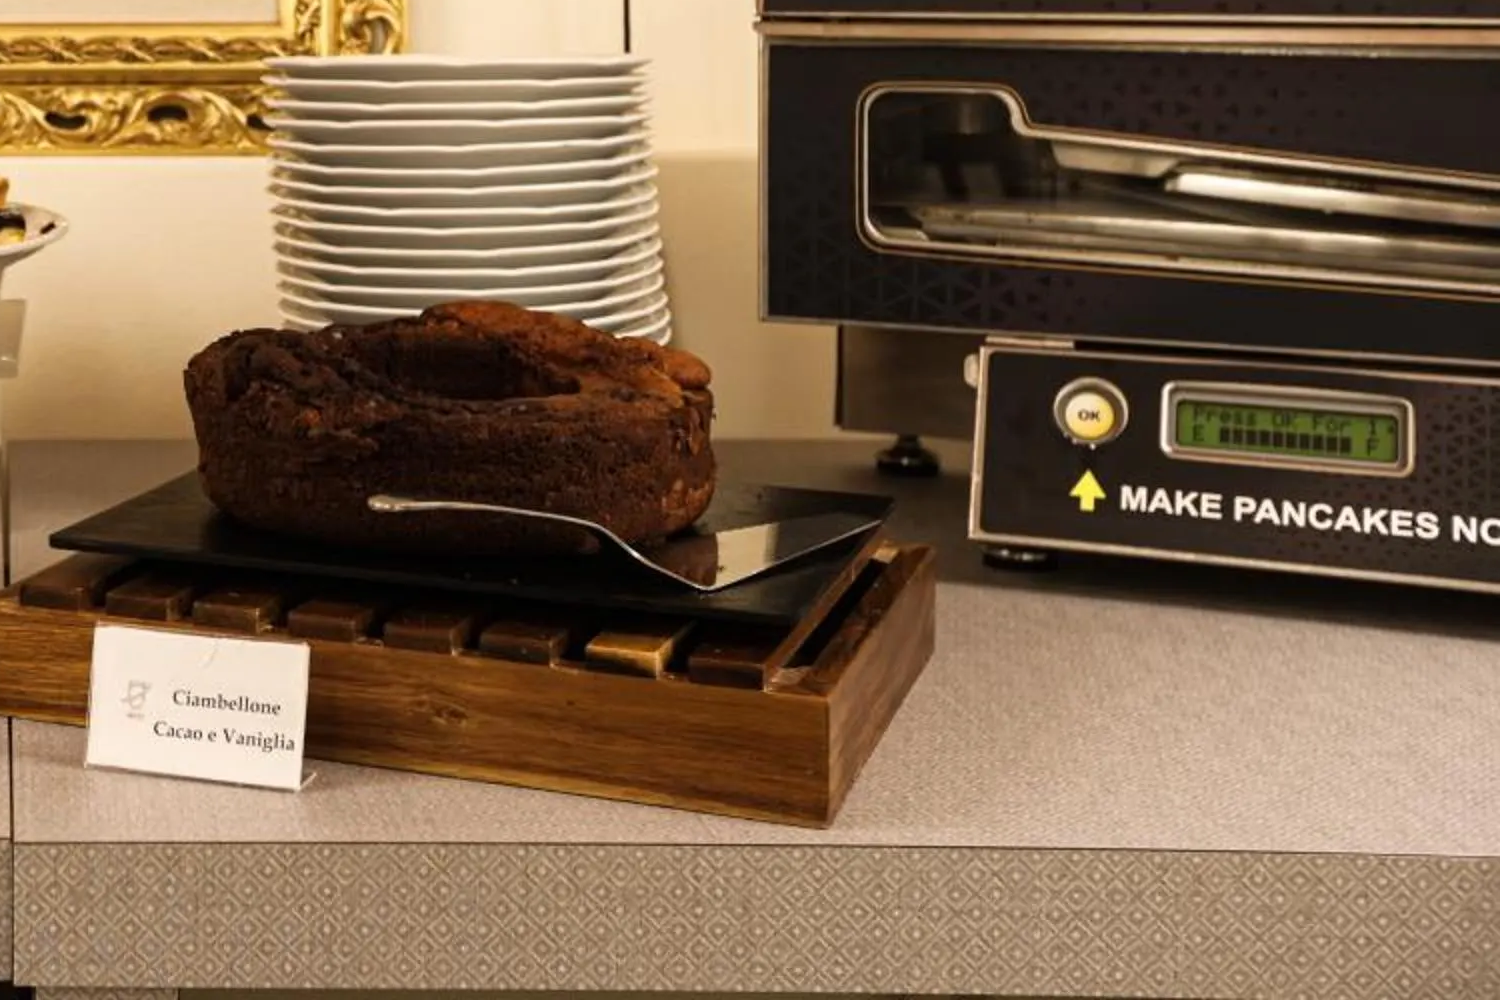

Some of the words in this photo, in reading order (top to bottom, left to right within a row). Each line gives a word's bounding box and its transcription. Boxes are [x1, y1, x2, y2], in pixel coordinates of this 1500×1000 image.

[1077, 409, 1101, 423] OK
[1192, 423, 1205, 442] E
[1120, 484, 1223, 520] MAKE
[1233, 496, 1440, 540] PANCAKES
[172, 688, 282, 716] Ciambellone
[152, 719, 203, 742] Cacao
[207, 730, 217, 742] e
[222, 727, 296, 753] Vaniglia
